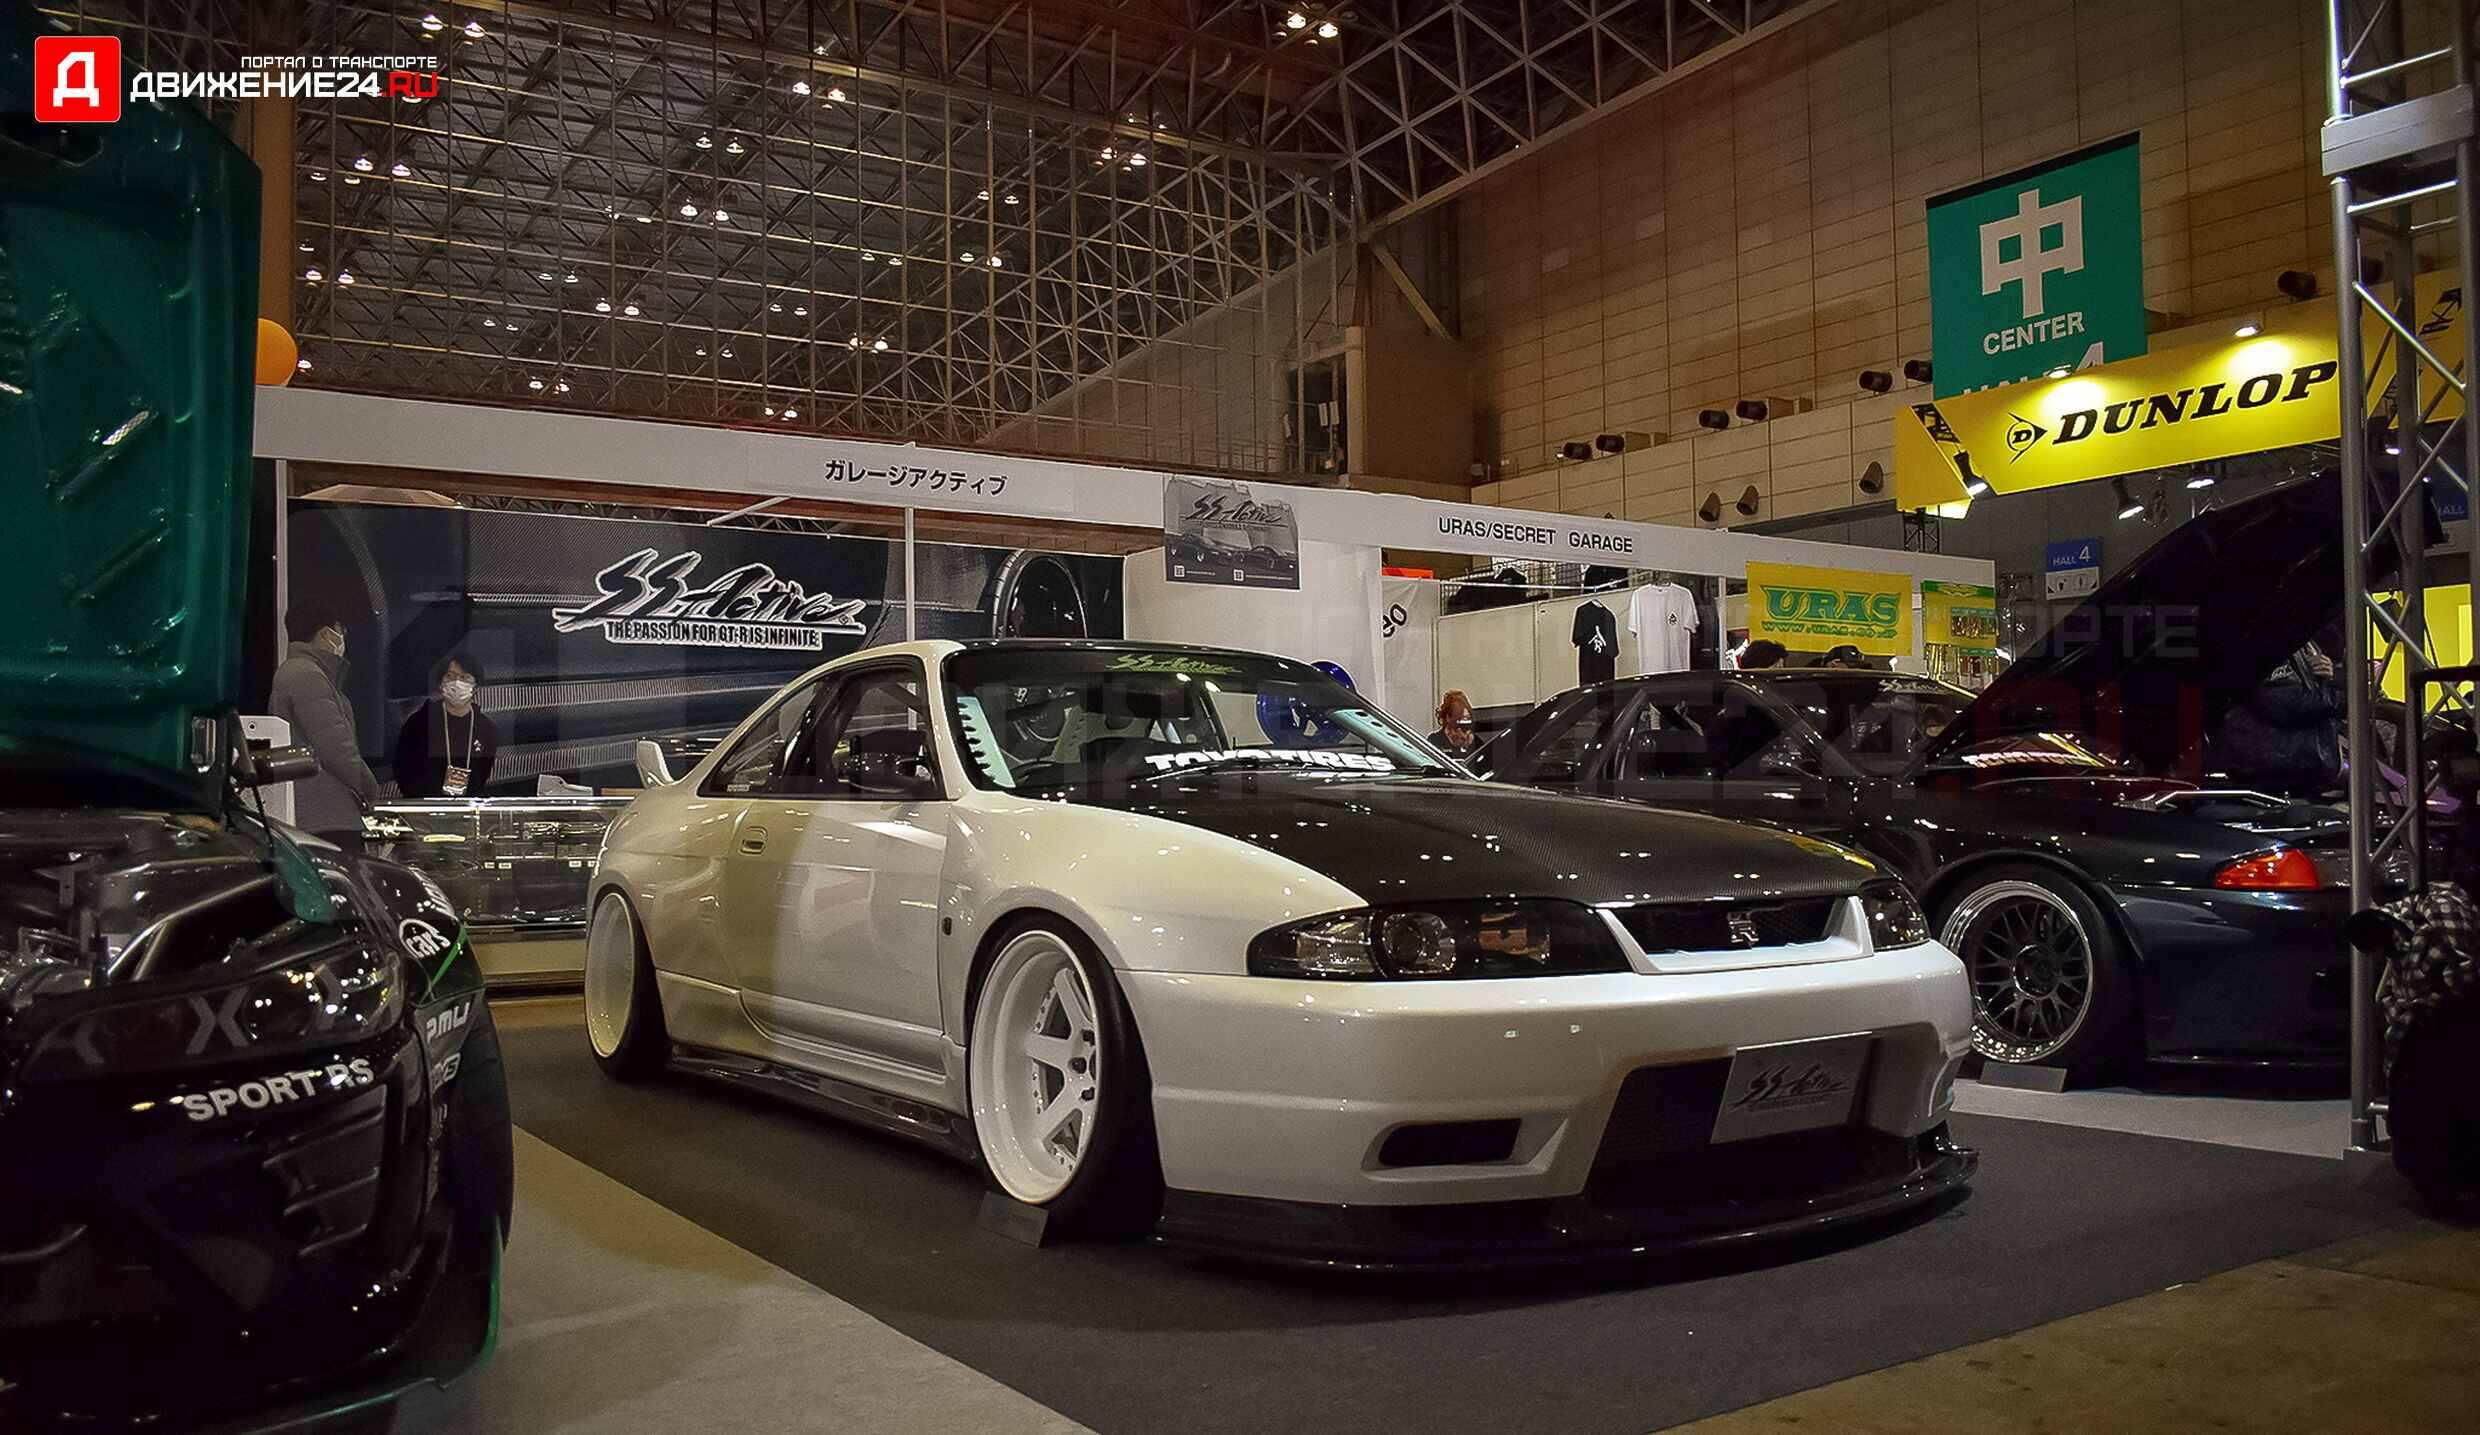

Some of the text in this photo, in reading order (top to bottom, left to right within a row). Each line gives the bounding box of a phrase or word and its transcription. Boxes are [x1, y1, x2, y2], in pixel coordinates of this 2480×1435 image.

[1980, 189, 2085, 319] 中
[1983, 311, 2086, 356] CENTER
[2051, 360, 2339, 446] DUNLOP
[825, 459, 1008, 496] ガレージアクティブ
[1438, 516, 1634, 554] URAS/SECRET GARAGE
[2079, 545, 2092, 563] 4
[1760, 585, 1901, 628] URAS
[606, 621, 634, 640] THE
[634, 622, 690, 641] PASSION
[692, 623, 716, 642] FOR
[750, 626, 764, 644] IS
[183, 1056, 376, 1122] SPORT RS
